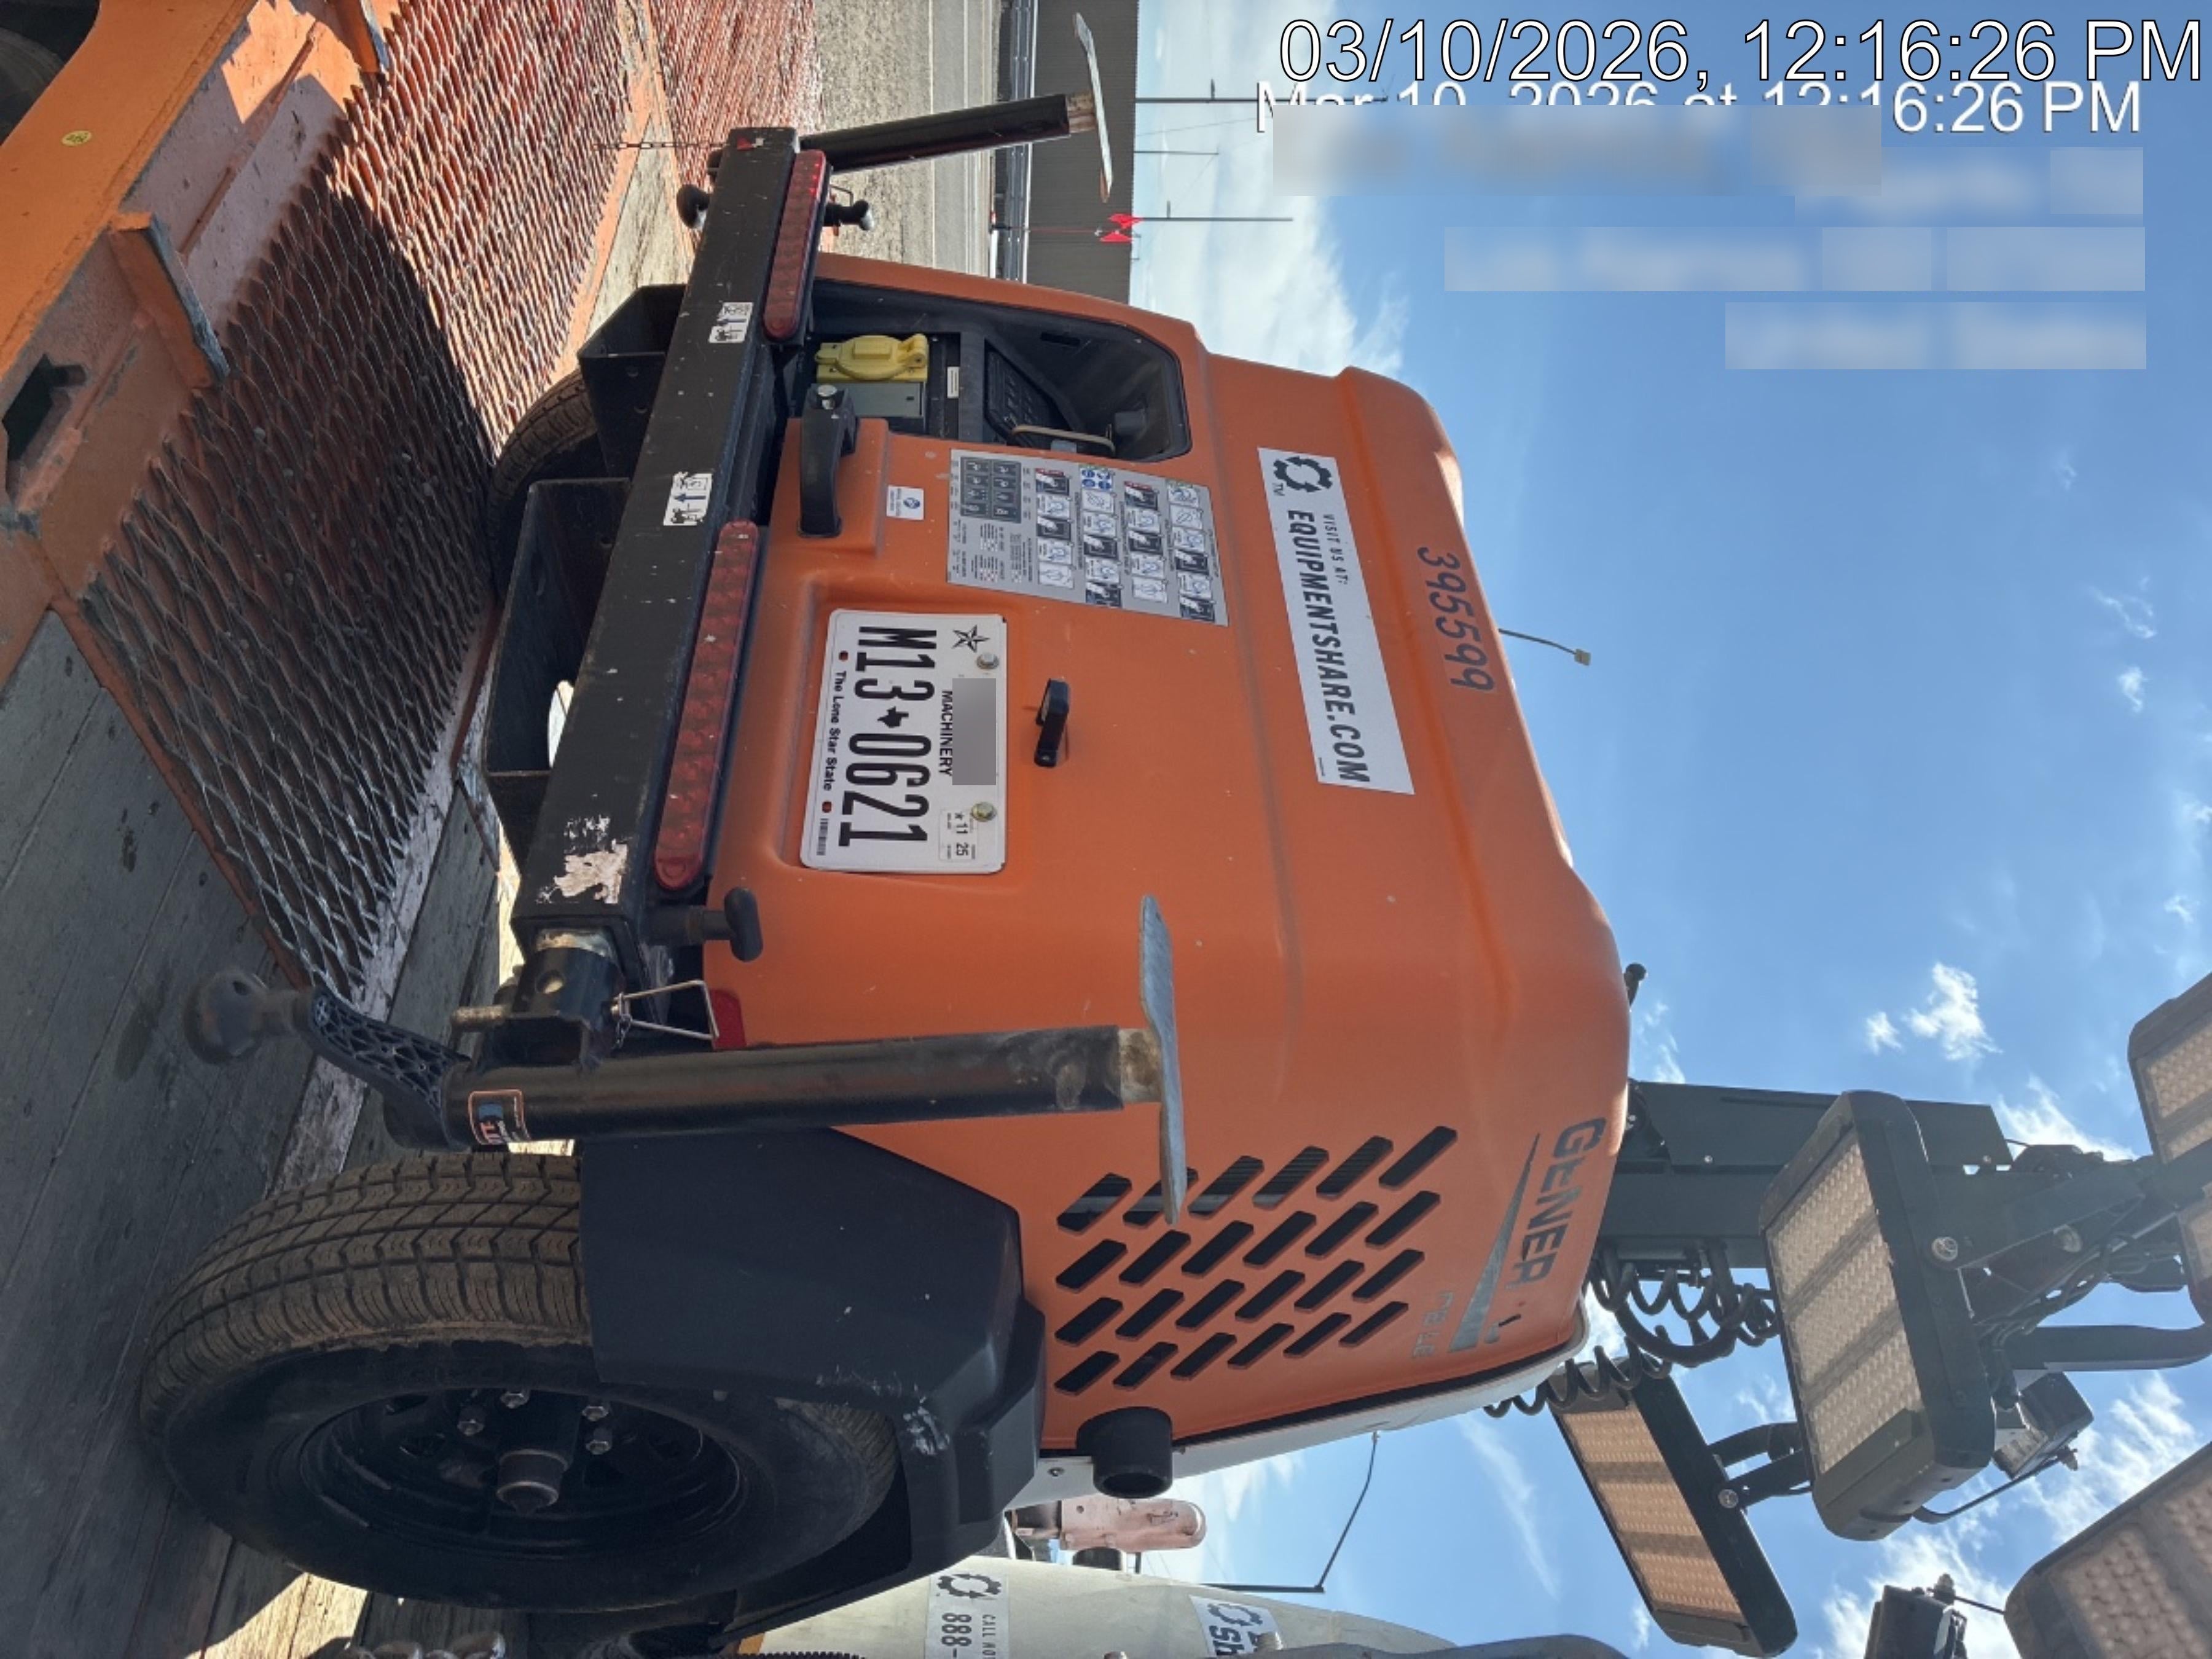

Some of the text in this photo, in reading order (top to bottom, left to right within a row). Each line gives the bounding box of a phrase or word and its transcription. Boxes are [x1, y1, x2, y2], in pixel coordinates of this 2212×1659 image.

[1323, 514, 1348, 585] VISIT US AT:
[1287, 510, 1370, 783] EQUIPMENTSHARE.COM
[1417, 547, 1495, 691] 395599
[823, 670, 847, 791] The Lone Star State
[838, 626, 937, 847] M13 0621
[939, 690, 953, 777] MACHINERY
[955, 823, 969, 857] 11 25
[982, 1614, 996, 1659] CALL NO
